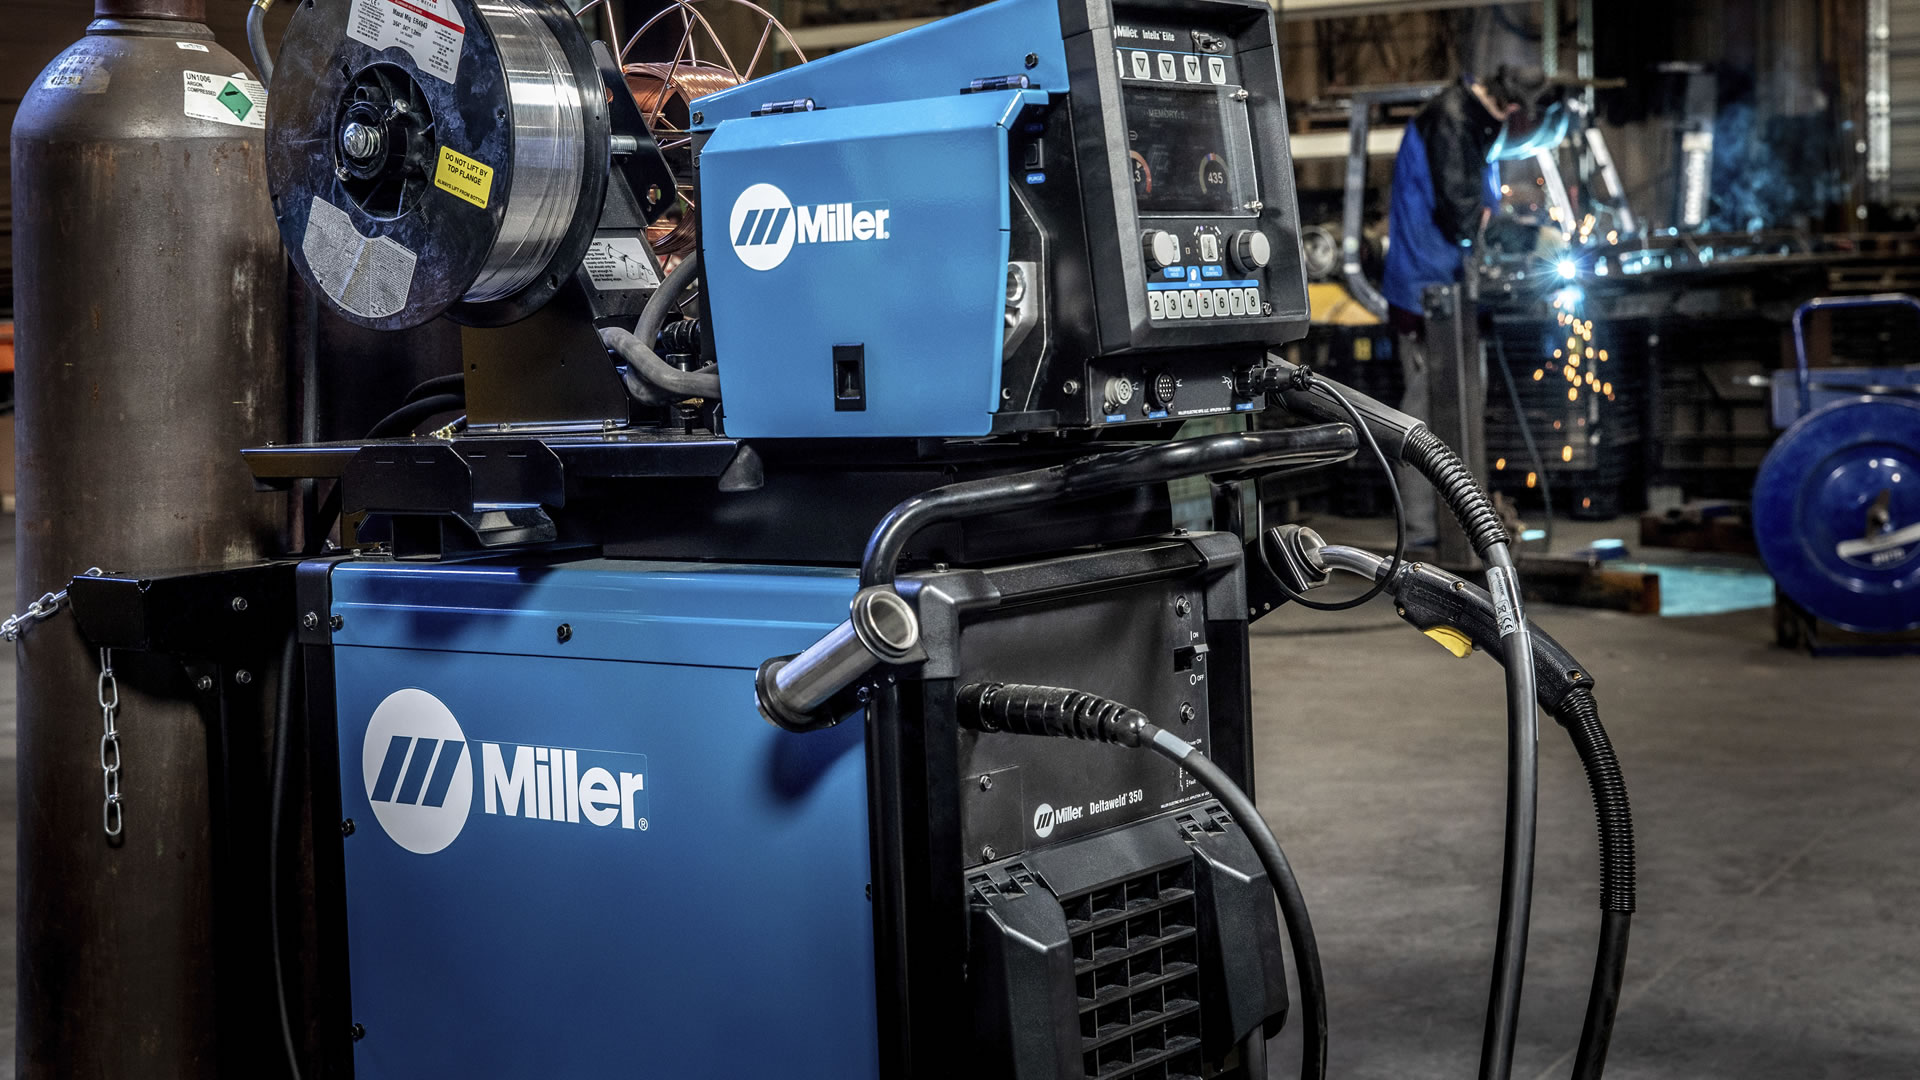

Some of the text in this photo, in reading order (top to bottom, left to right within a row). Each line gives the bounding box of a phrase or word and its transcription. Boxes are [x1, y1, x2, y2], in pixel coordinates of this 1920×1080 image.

[1162, 31, 1175, 41] Elite
[186, 72, 212, 83] UN1006
[187, 86, 217, 96] COMPRESSED
[445, 152, 488, 178] DO NOT LIFT BY
[448, 163, 482, 186] TOP FLANGE
[1208, 172, 1224, 184] 435
[437, 178, 452, 188] ALWAYS
[460, 189, 470, 198] FROM
[470, 194, 486, 205] BOTTOM
[1154, 296, 1256, 311] 2 3 4 5 6 7 8
[1128, 789, 1143, 804] 350
